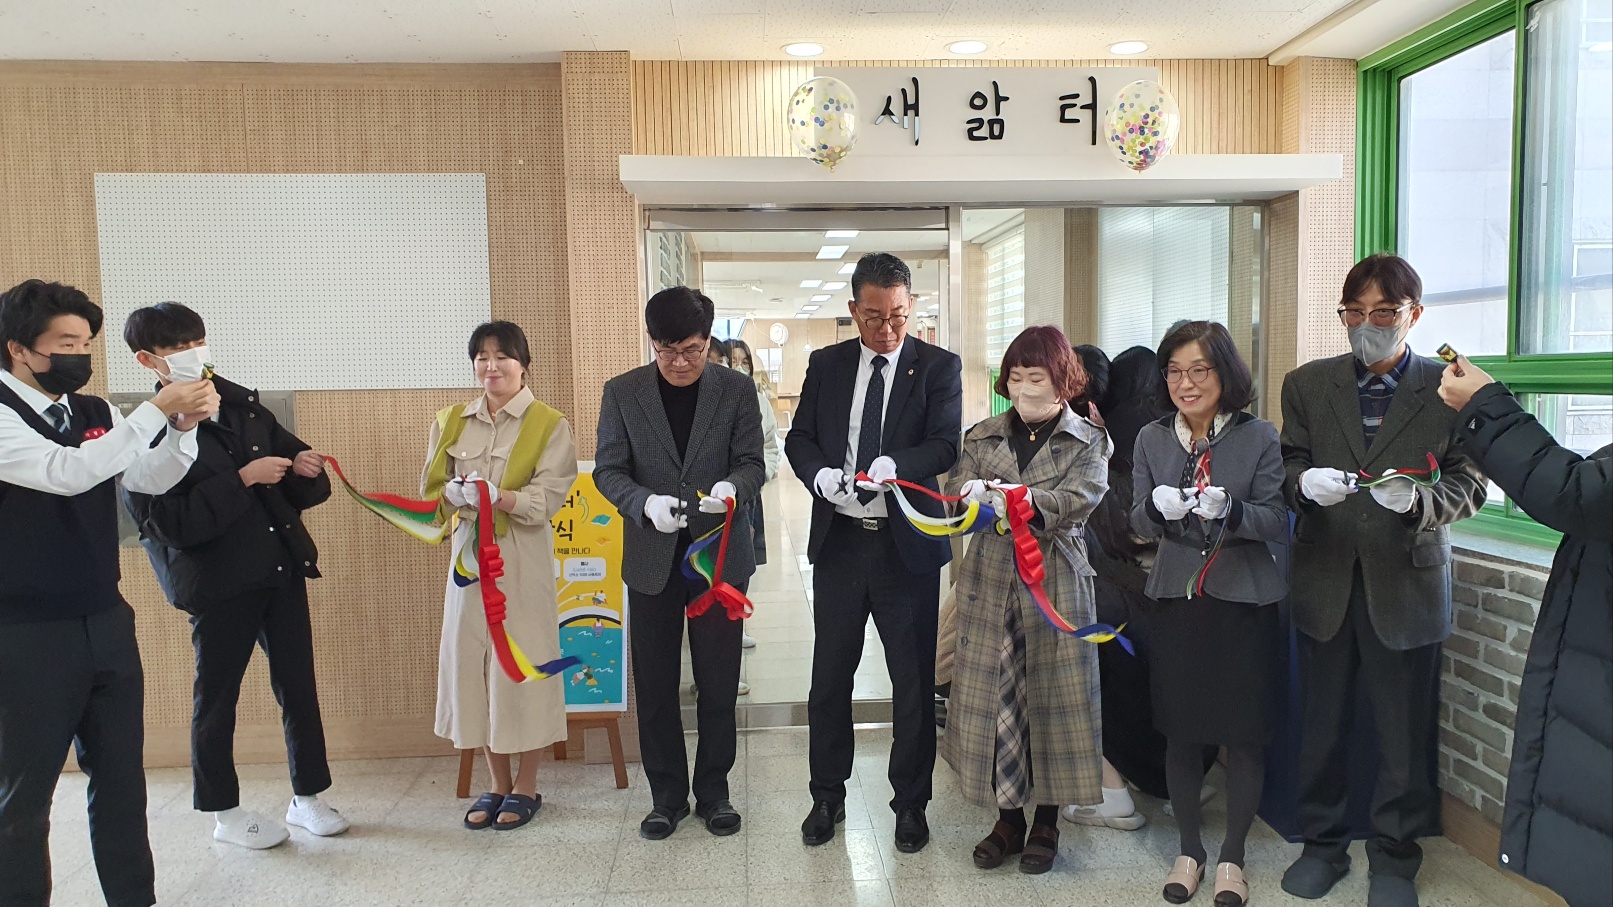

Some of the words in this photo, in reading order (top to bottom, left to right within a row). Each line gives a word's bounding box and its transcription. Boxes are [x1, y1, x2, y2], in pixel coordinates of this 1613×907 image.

[874, 76, 920, 146] 새
[965, 80, 1010, 141] 앎
[1058, 76, 1098, 146] 터
